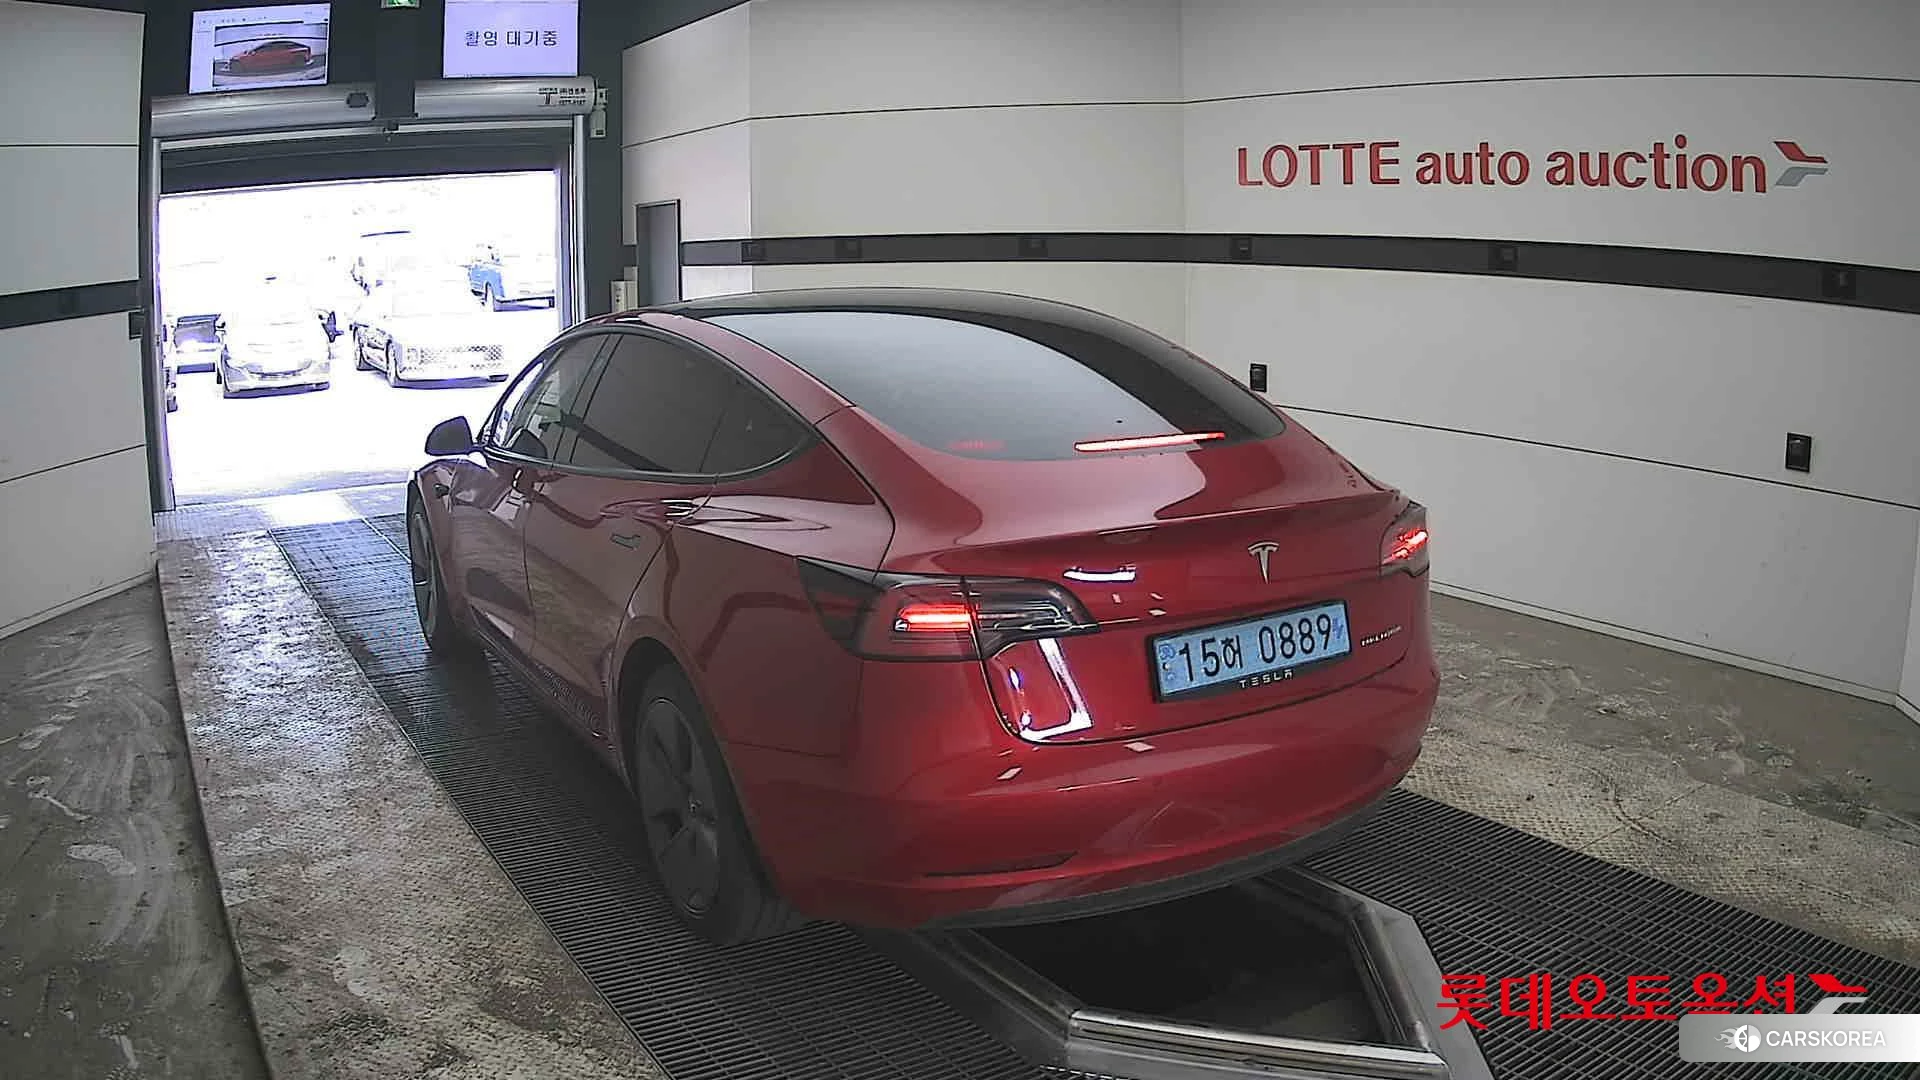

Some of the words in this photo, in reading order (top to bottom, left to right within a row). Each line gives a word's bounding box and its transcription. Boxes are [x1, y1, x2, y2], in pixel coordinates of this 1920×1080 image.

[506, 30, 557, 47] 대기중
[1237, 141, 1400, 187] LOTTE
[1415, 142, 1530, 186] auto
[1545, 134, 1767, 193] auction
[1179, 635, 1244, 682] 15허
[1258, 614, 1331, 664] 0889
[1239, 669, 1293, 689] TESLA
